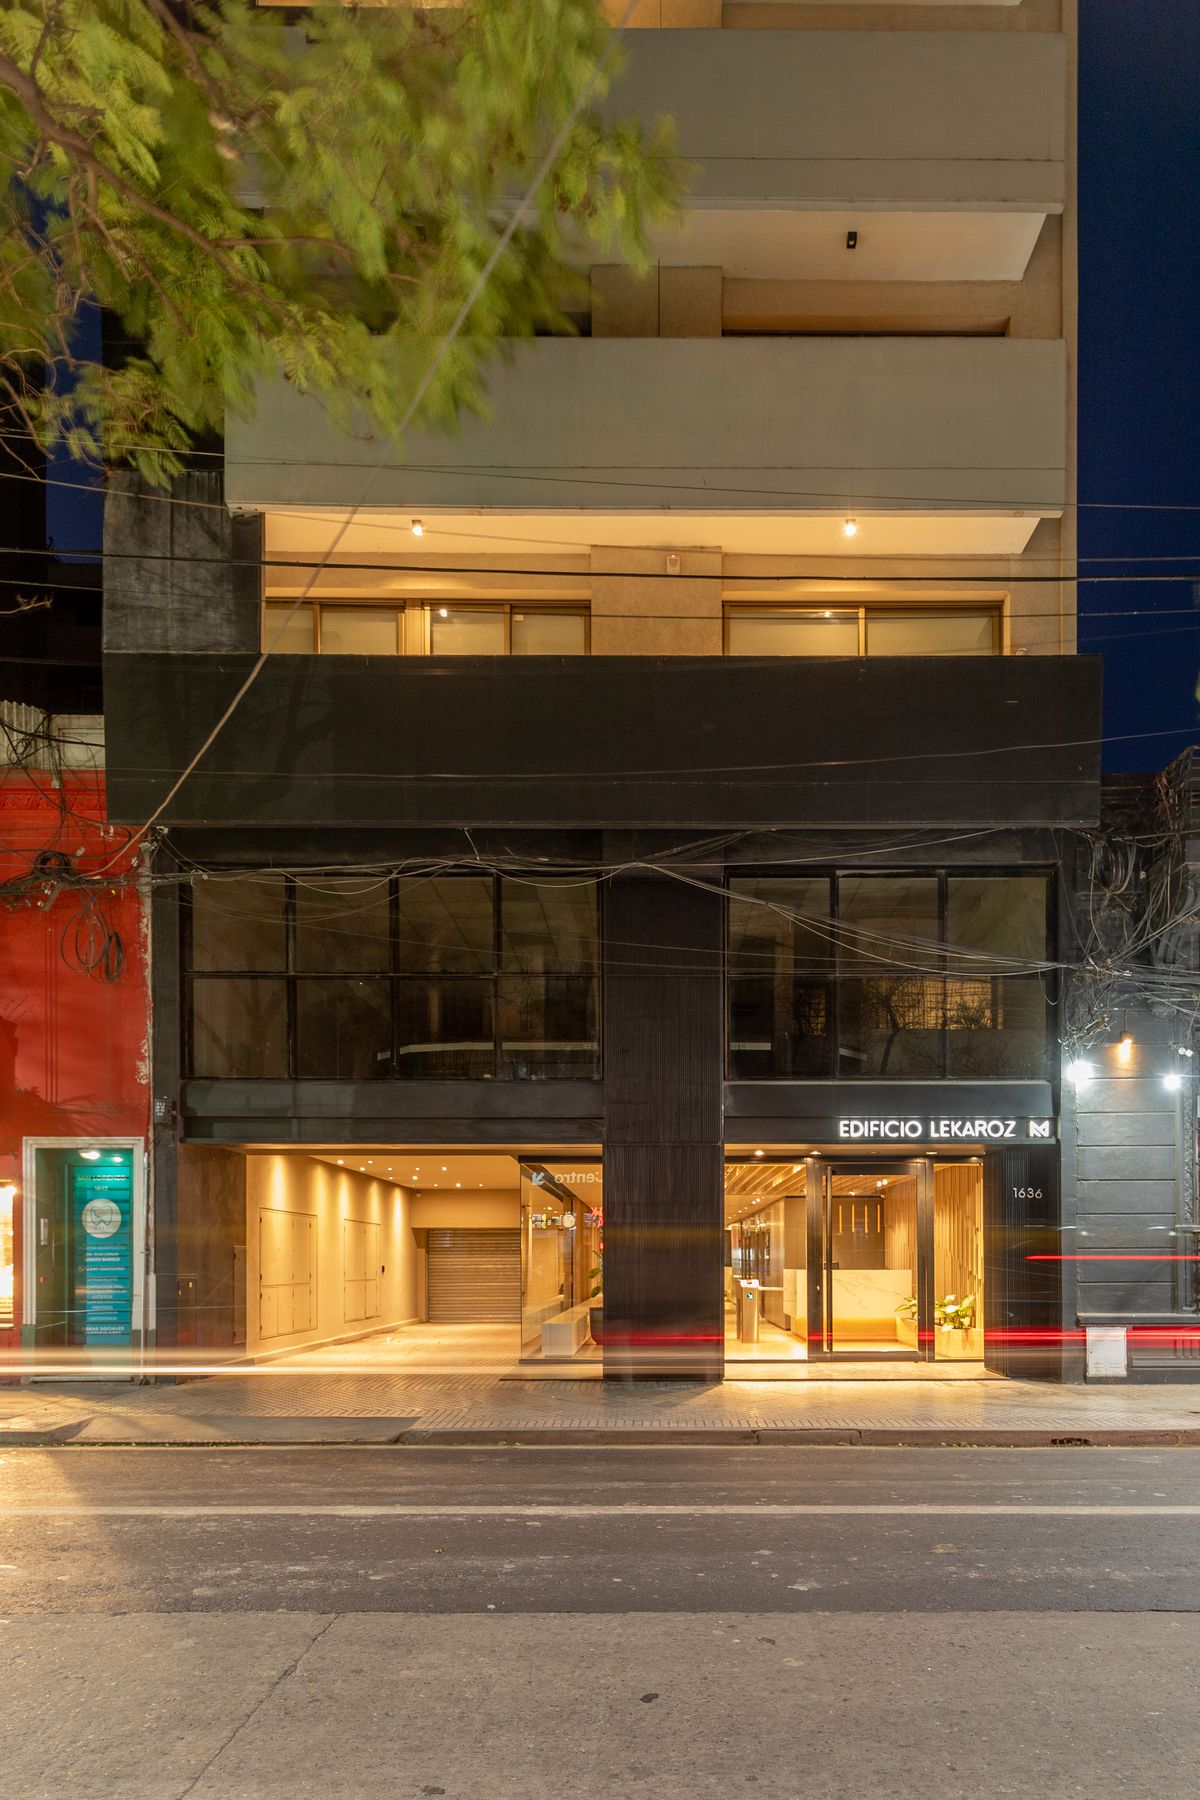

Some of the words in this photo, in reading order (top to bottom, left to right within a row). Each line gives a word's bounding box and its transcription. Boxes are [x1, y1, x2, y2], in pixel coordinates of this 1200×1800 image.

[838, 1119, 923, 1138] EDIFICIO
[929, 1119, 1017, 1138] LEKAROZ
[1011, 1187, 1043, 1199] 1636
